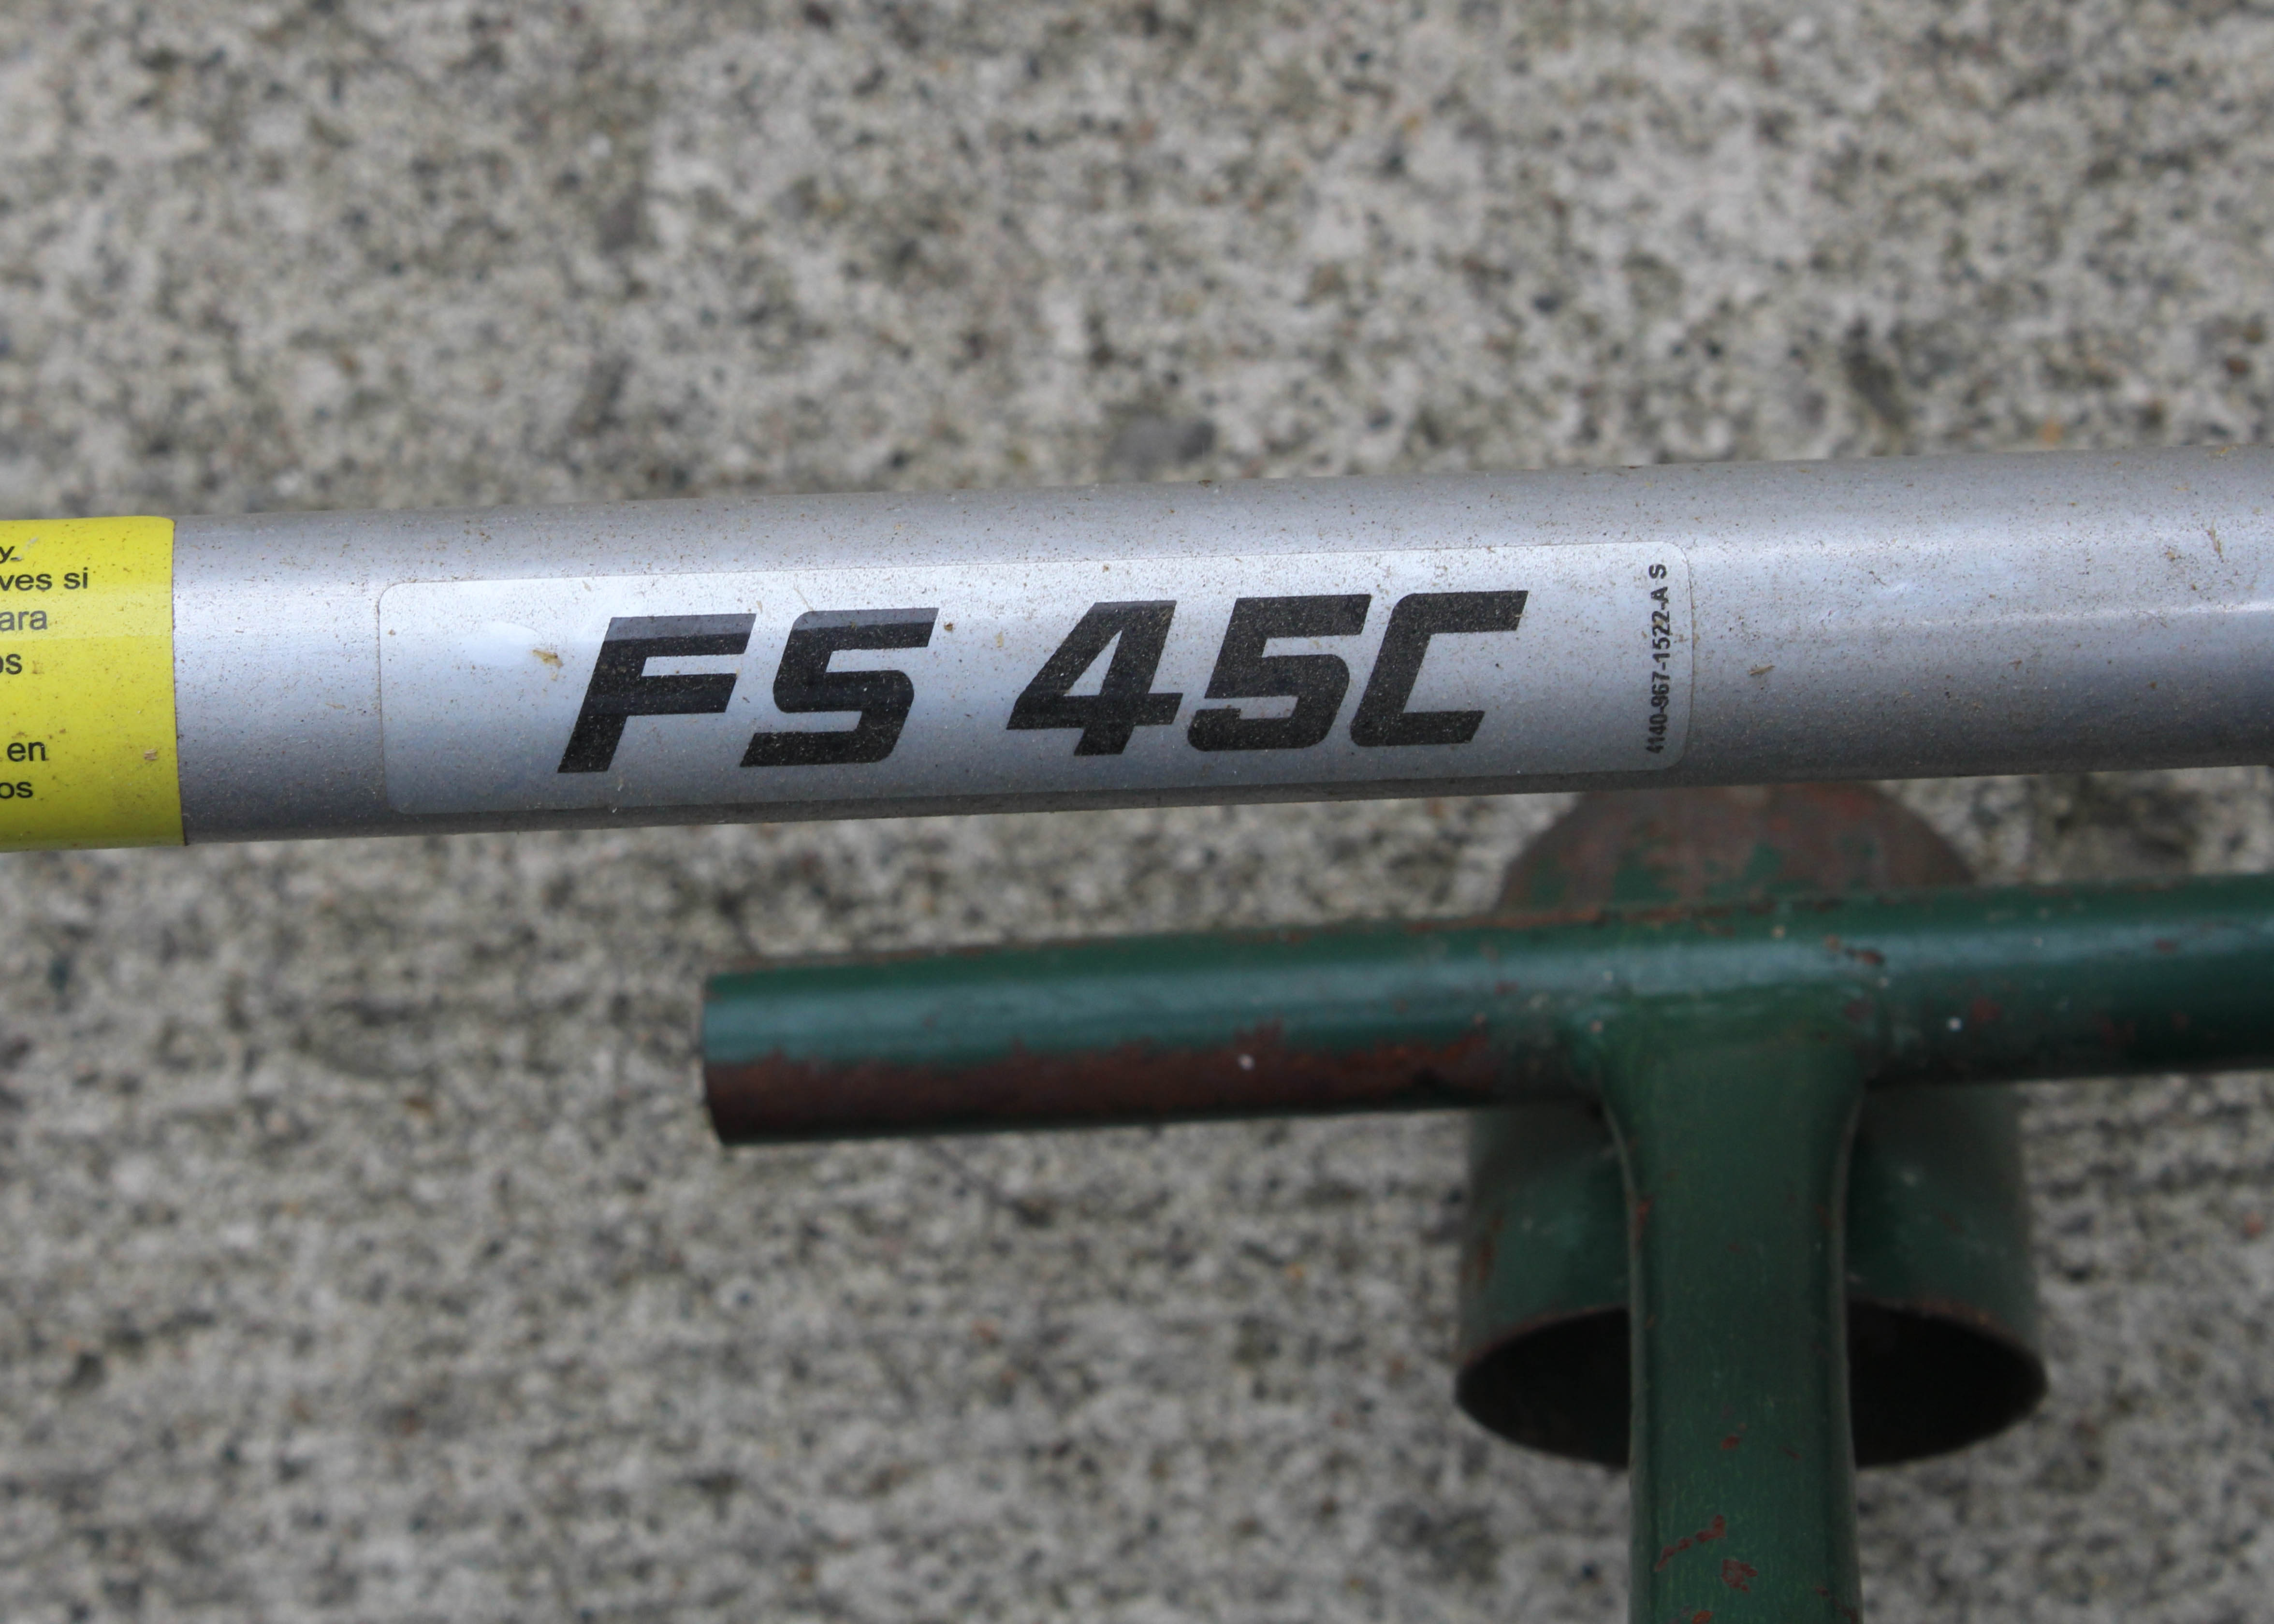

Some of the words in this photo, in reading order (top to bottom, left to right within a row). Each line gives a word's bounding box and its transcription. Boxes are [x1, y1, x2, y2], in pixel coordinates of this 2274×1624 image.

[63, 566, 88, 590] si
[1648, 564, 1667, 579] S
[0, 653, 22, 675] s
[557, 607, 939, 774] FS
[1006, 590, 1529, 756] 45C
[7, 741, 46, 762] en
